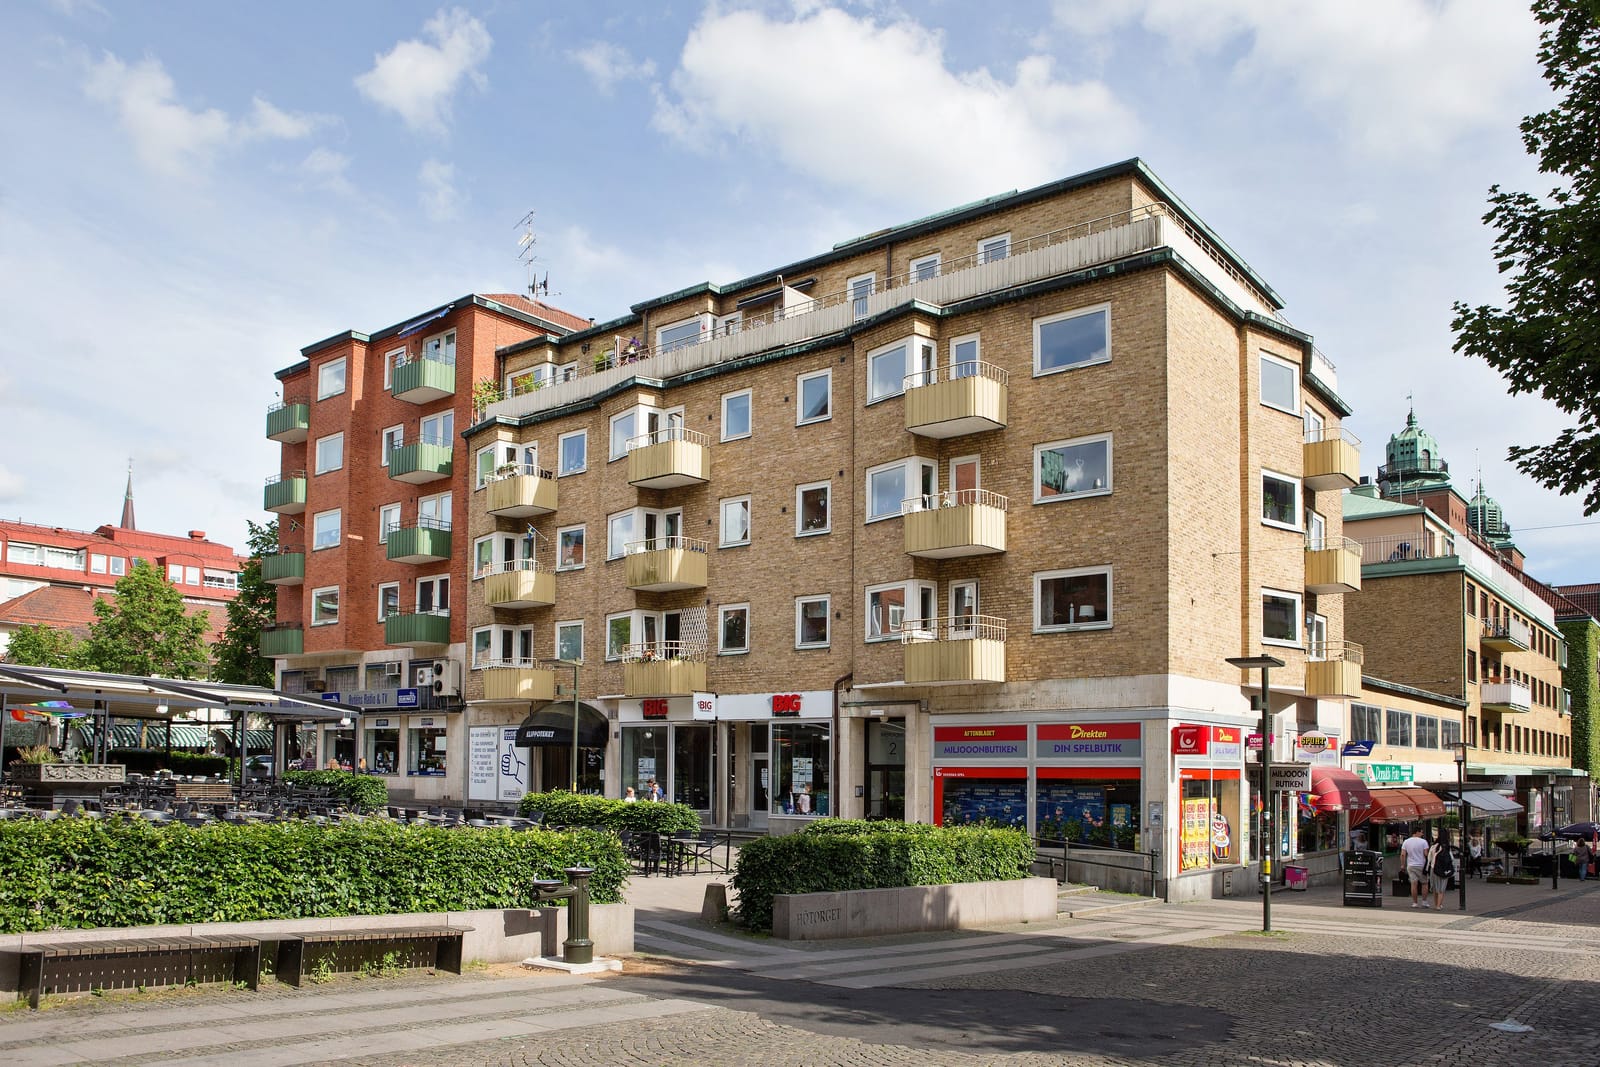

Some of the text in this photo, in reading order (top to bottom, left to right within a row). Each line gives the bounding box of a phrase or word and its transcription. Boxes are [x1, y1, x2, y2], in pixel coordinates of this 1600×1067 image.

[643, 698, 668, 715] BIG
[699, 701, 712, 710] BIG
[772, 694, 801, 713] BIG
[1070, 725, 1107, 739] Direkten
[888, 742, 897, 755] 2
[944, 745, 1018, 754] MILJOOONBUTIKEN
[1054, 743, 1122, 753] DIN SPELBUTIK
[1271, 770, 1308, 778] MILJOOON
[1275, 780, 1304, 788] BUTIKEN
